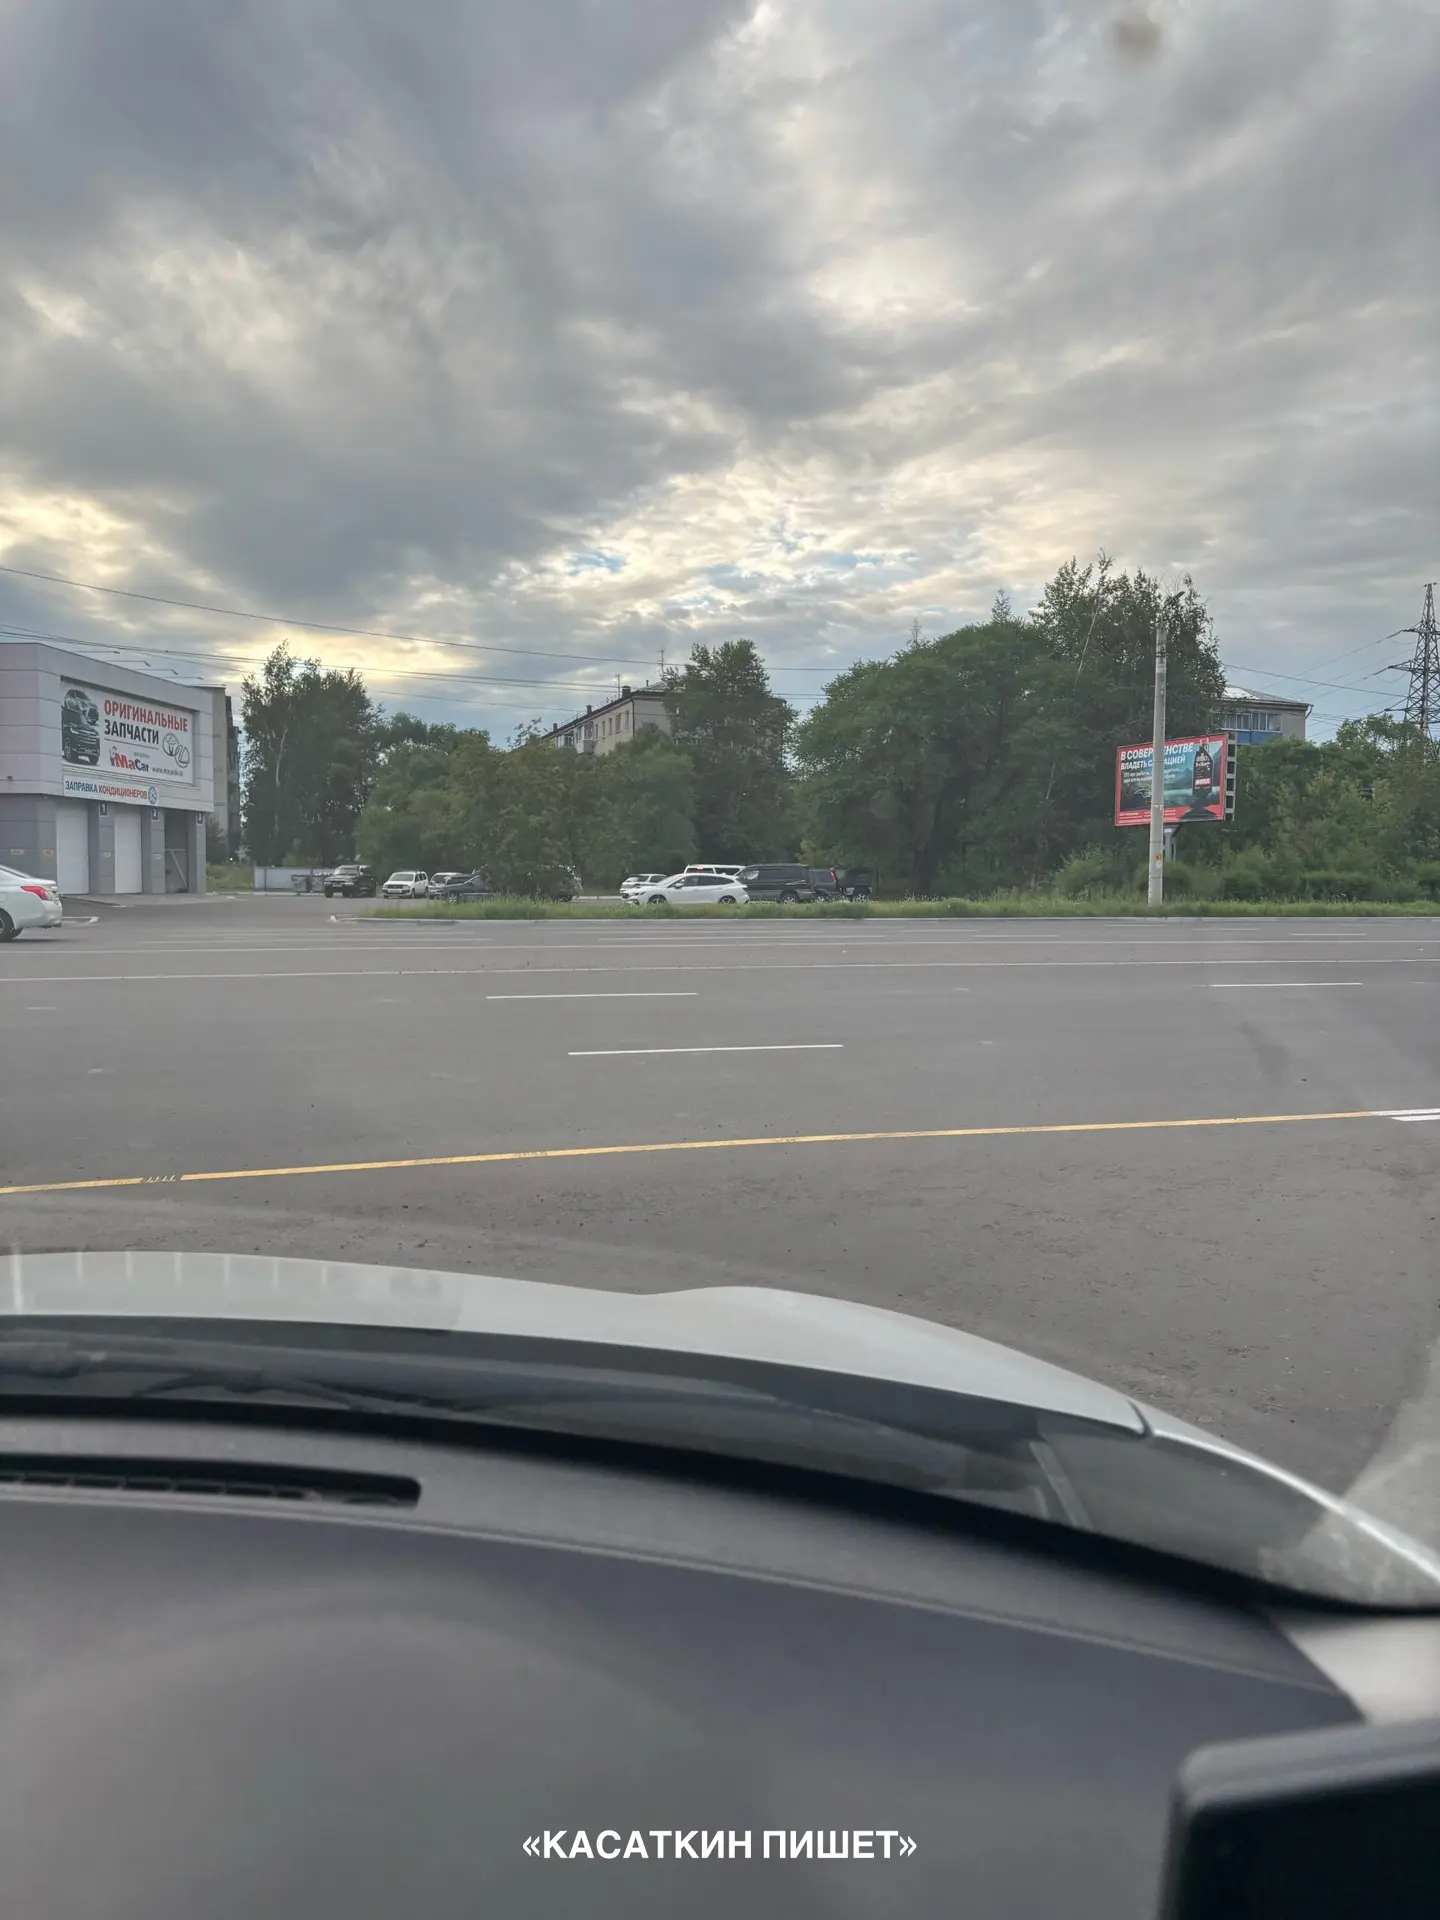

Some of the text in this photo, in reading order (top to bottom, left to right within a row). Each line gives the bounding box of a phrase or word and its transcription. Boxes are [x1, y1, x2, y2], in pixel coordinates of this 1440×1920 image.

[104, 699, 188, 732] ОРИГИНАЛЬНЫЕ
[104, 719, 159, 744] ЗАПЧАСТИ
[1127, 743, 1194, 760] СОВЕРНСТВЕ
[1148, 754, 1186, 767] САЦИЕЙ
[65, 780, 148, 800] ЗАПРАВКА КОНДИЦИОНЕРОВ
